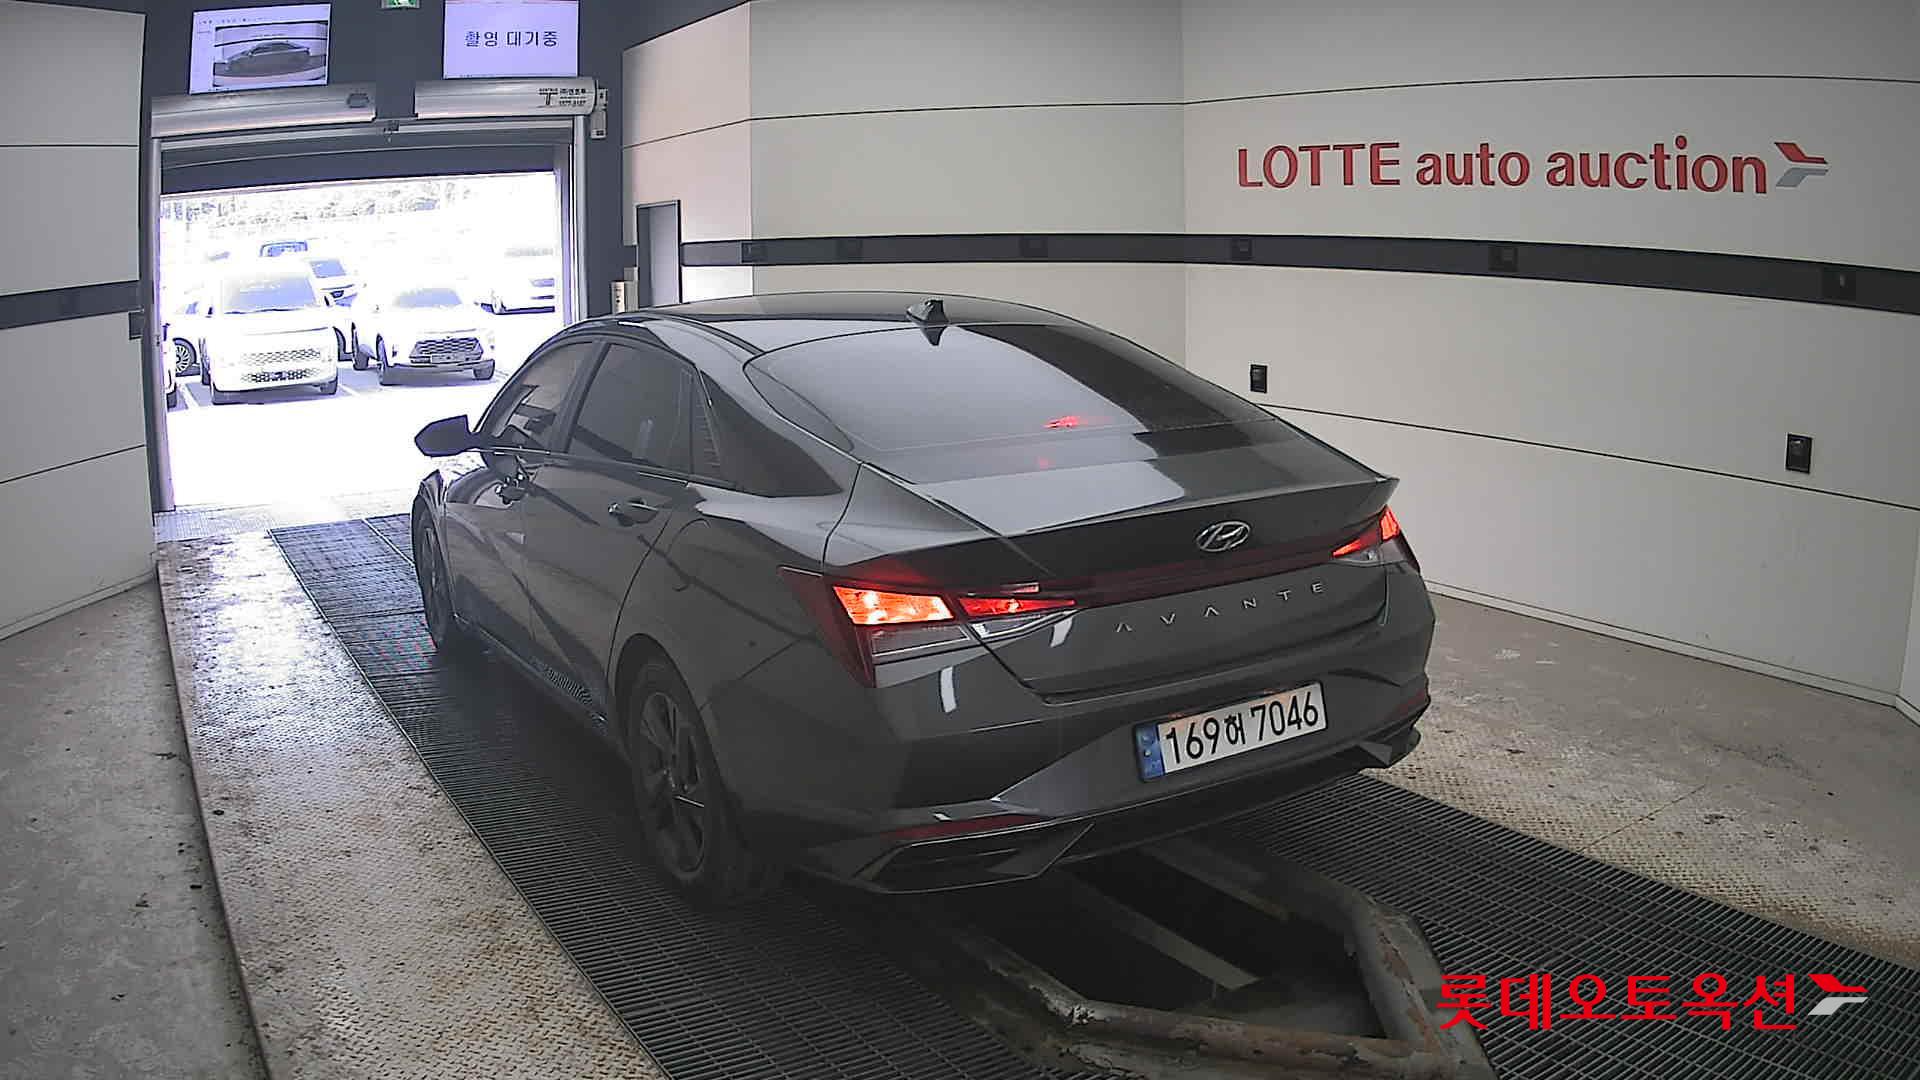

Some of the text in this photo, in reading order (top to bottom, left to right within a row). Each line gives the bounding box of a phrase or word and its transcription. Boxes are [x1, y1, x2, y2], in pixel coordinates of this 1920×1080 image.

[506, 31, 557, 47] 대기중
[1237, 136, 1767, 194] LOTTE auto auction
[1116, 582, 1323, 633] AVANTE
[1165, 691, 1319, 764] 169허 7046
